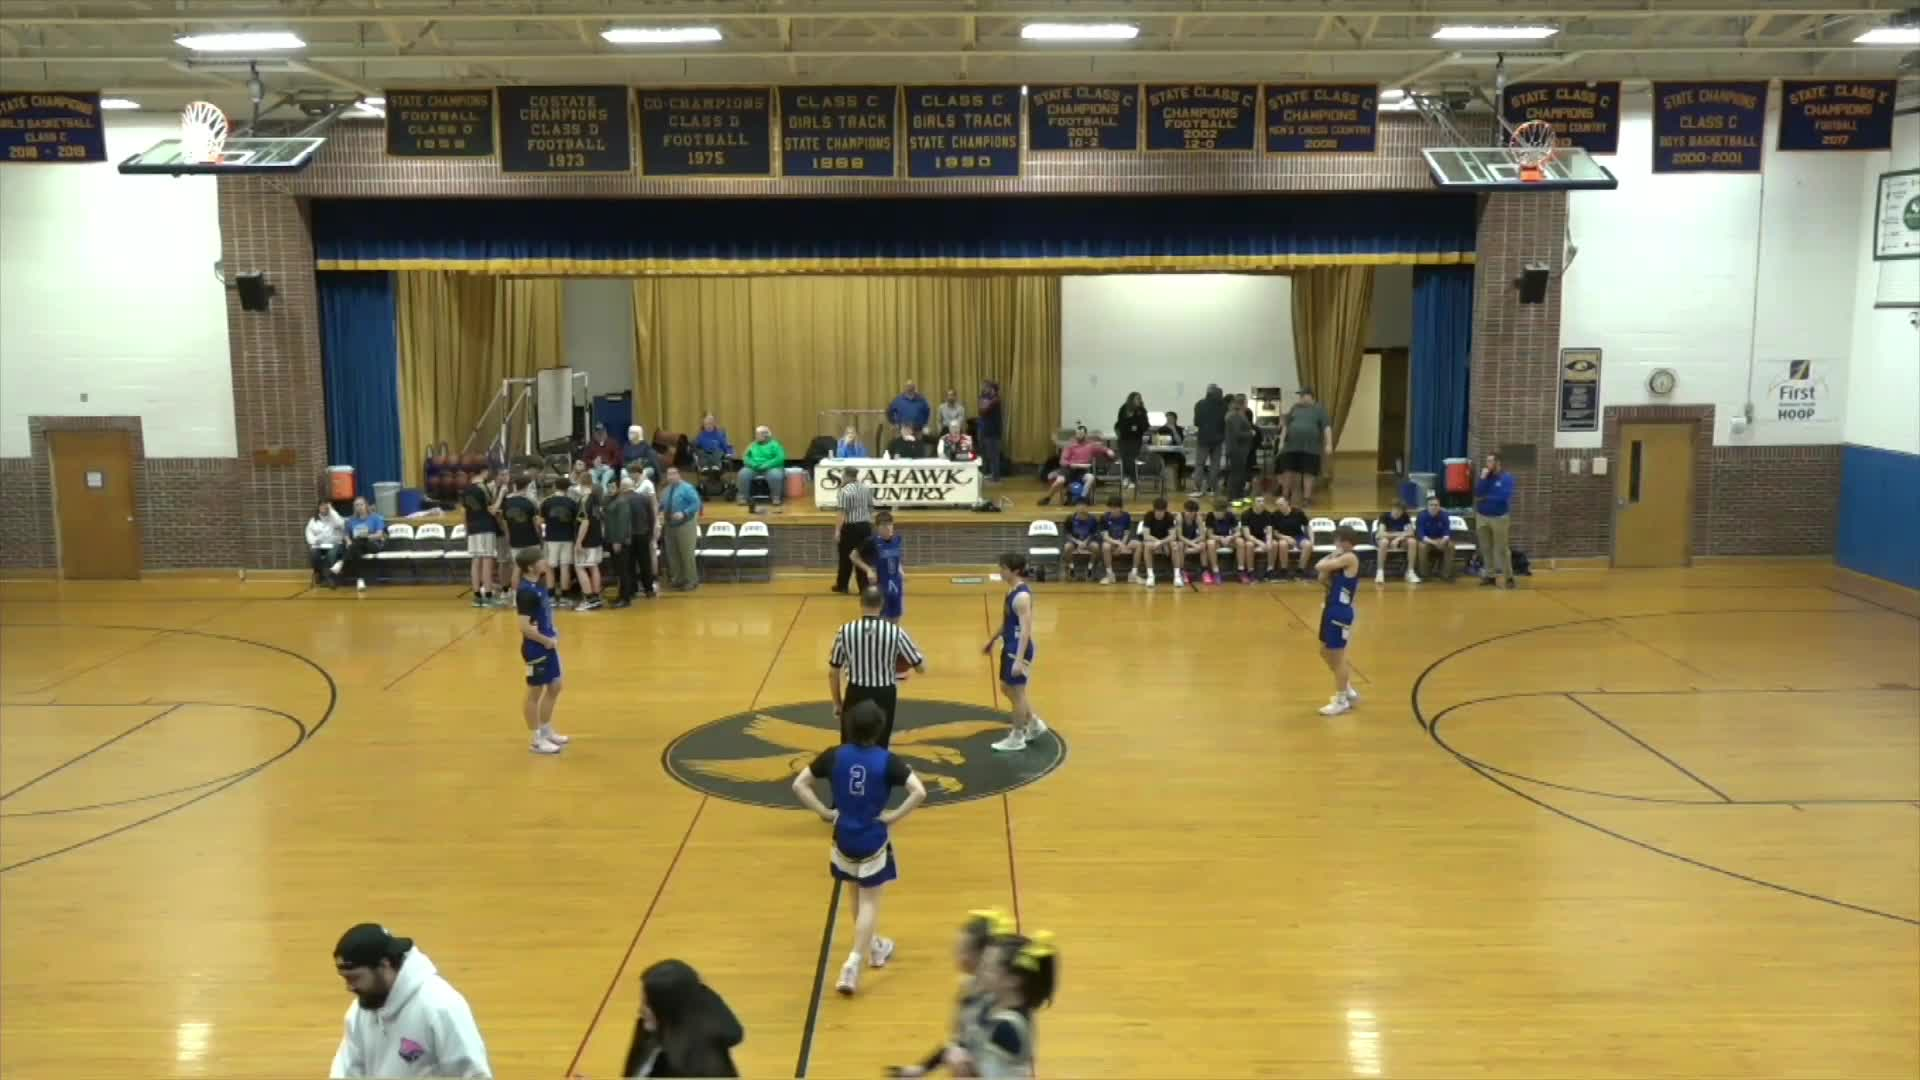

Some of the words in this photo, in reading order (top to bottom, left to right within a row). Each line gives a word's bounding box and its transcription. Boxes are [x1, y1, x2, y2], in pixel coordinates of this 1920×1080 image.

[921, 95, 984, 107] CLASS
[991, 95, 1005, 106] C
[1033, 88, 1073, 107] STATE
[1076, 86, 1121, 103] CLASS
[1122, 94, 1135, 107] C
[1150, 88, 1190, 107] STATE
[1193, 87, 1240, 103] CLASS
[1241, 94, 1253, 107] C
[1267, 90, 1310, 110] STATE
[1313, 88, 1361, 105] CLASS
[1361, 97, 1373, 110] C
[1511, 89, 1550, 109] STATE
[1555, 87, 1597, 105] CLASS
[1599, 94, 1610, 109] C
[1663, 90, 1696, 110] STATE
[1698, 88, 1757, 109] CHAMPIONS
[1790, 86, 1828, 105] STATE
[1834, 84, 1876, 100] CLASS
[391, 96, 425, 107] STATE
[428, 96, 489, 107] CHAMPIONS
[796, 95, 858, 108] CLASS
[865, 95, 880, 107] C
[519, 108, 608, 121] CHAMPIONS
[1047, 102, 1119, 115] CHAMPIONS
[1162, 107, 1238, 119] CHAMPIONS
[1525, 107, 1594, 120] CHAMPIONS
[1803, 104, 1873, 117] CHAMPIONS
[402, 111, 480, 121] FOOTBALL
[669, 115, 723, 128] CLASS
[729, 115, 740, 128] D
[789, 115, 832, 129] GIRLS
[837, 114, 887, 129] TRACK
[913, 113, 956, 129] GIRLS
[963, 113, 1013, 129] TRACK
[1048, 117, 1119, 127] FOOTBALL
[1283, 110, 1357, 121] CHAMPIONS
[1679, 115, 1724, 129] CLASS
[1727, 115, 1738, 129] C
[531, 123, 581, 136] CLASS
[589, 123, 600, 136] D
[1164, 118, 1236, 128] FOOTBALL
[1569, 122, 1608, 133] COUNTRY
[1815, 120, 1857, 131] FOOTBALL
[408, 124, 458, 136] CLASS
[1067, 127, 1099, 137] 2001
[1183, 129, 1217, 139] 2002
[1298, 126, 1328, 136] CROSS
[1330, 126, 1371, 136] COUNTRY
[24, 132, 57, 143] CLASS
[663, 132, 749, 147] FOOTBALL
[784, 136, 821, 151] STATE
[826, 136, 892, 151] CHAMPIONS
[910, 135, 945, 149] STATE
[951, 135, 1017, 149] CHAMPIONS
[1184, 139, 1216, 149] 12-0
[1690, 135, 1760, 148] BASKETBALL
[527, 138, 606, 151] FOOTBALL
[548, 153, 585, 167] 1973
[687, 151, 725, 165] 1975
[1780, 385, 1816, 401] First
[1778, 408, 1816, 420] HOOP
[821, 468, 973, 490] SAHAWK
[849, 764, 867, 796] 2
